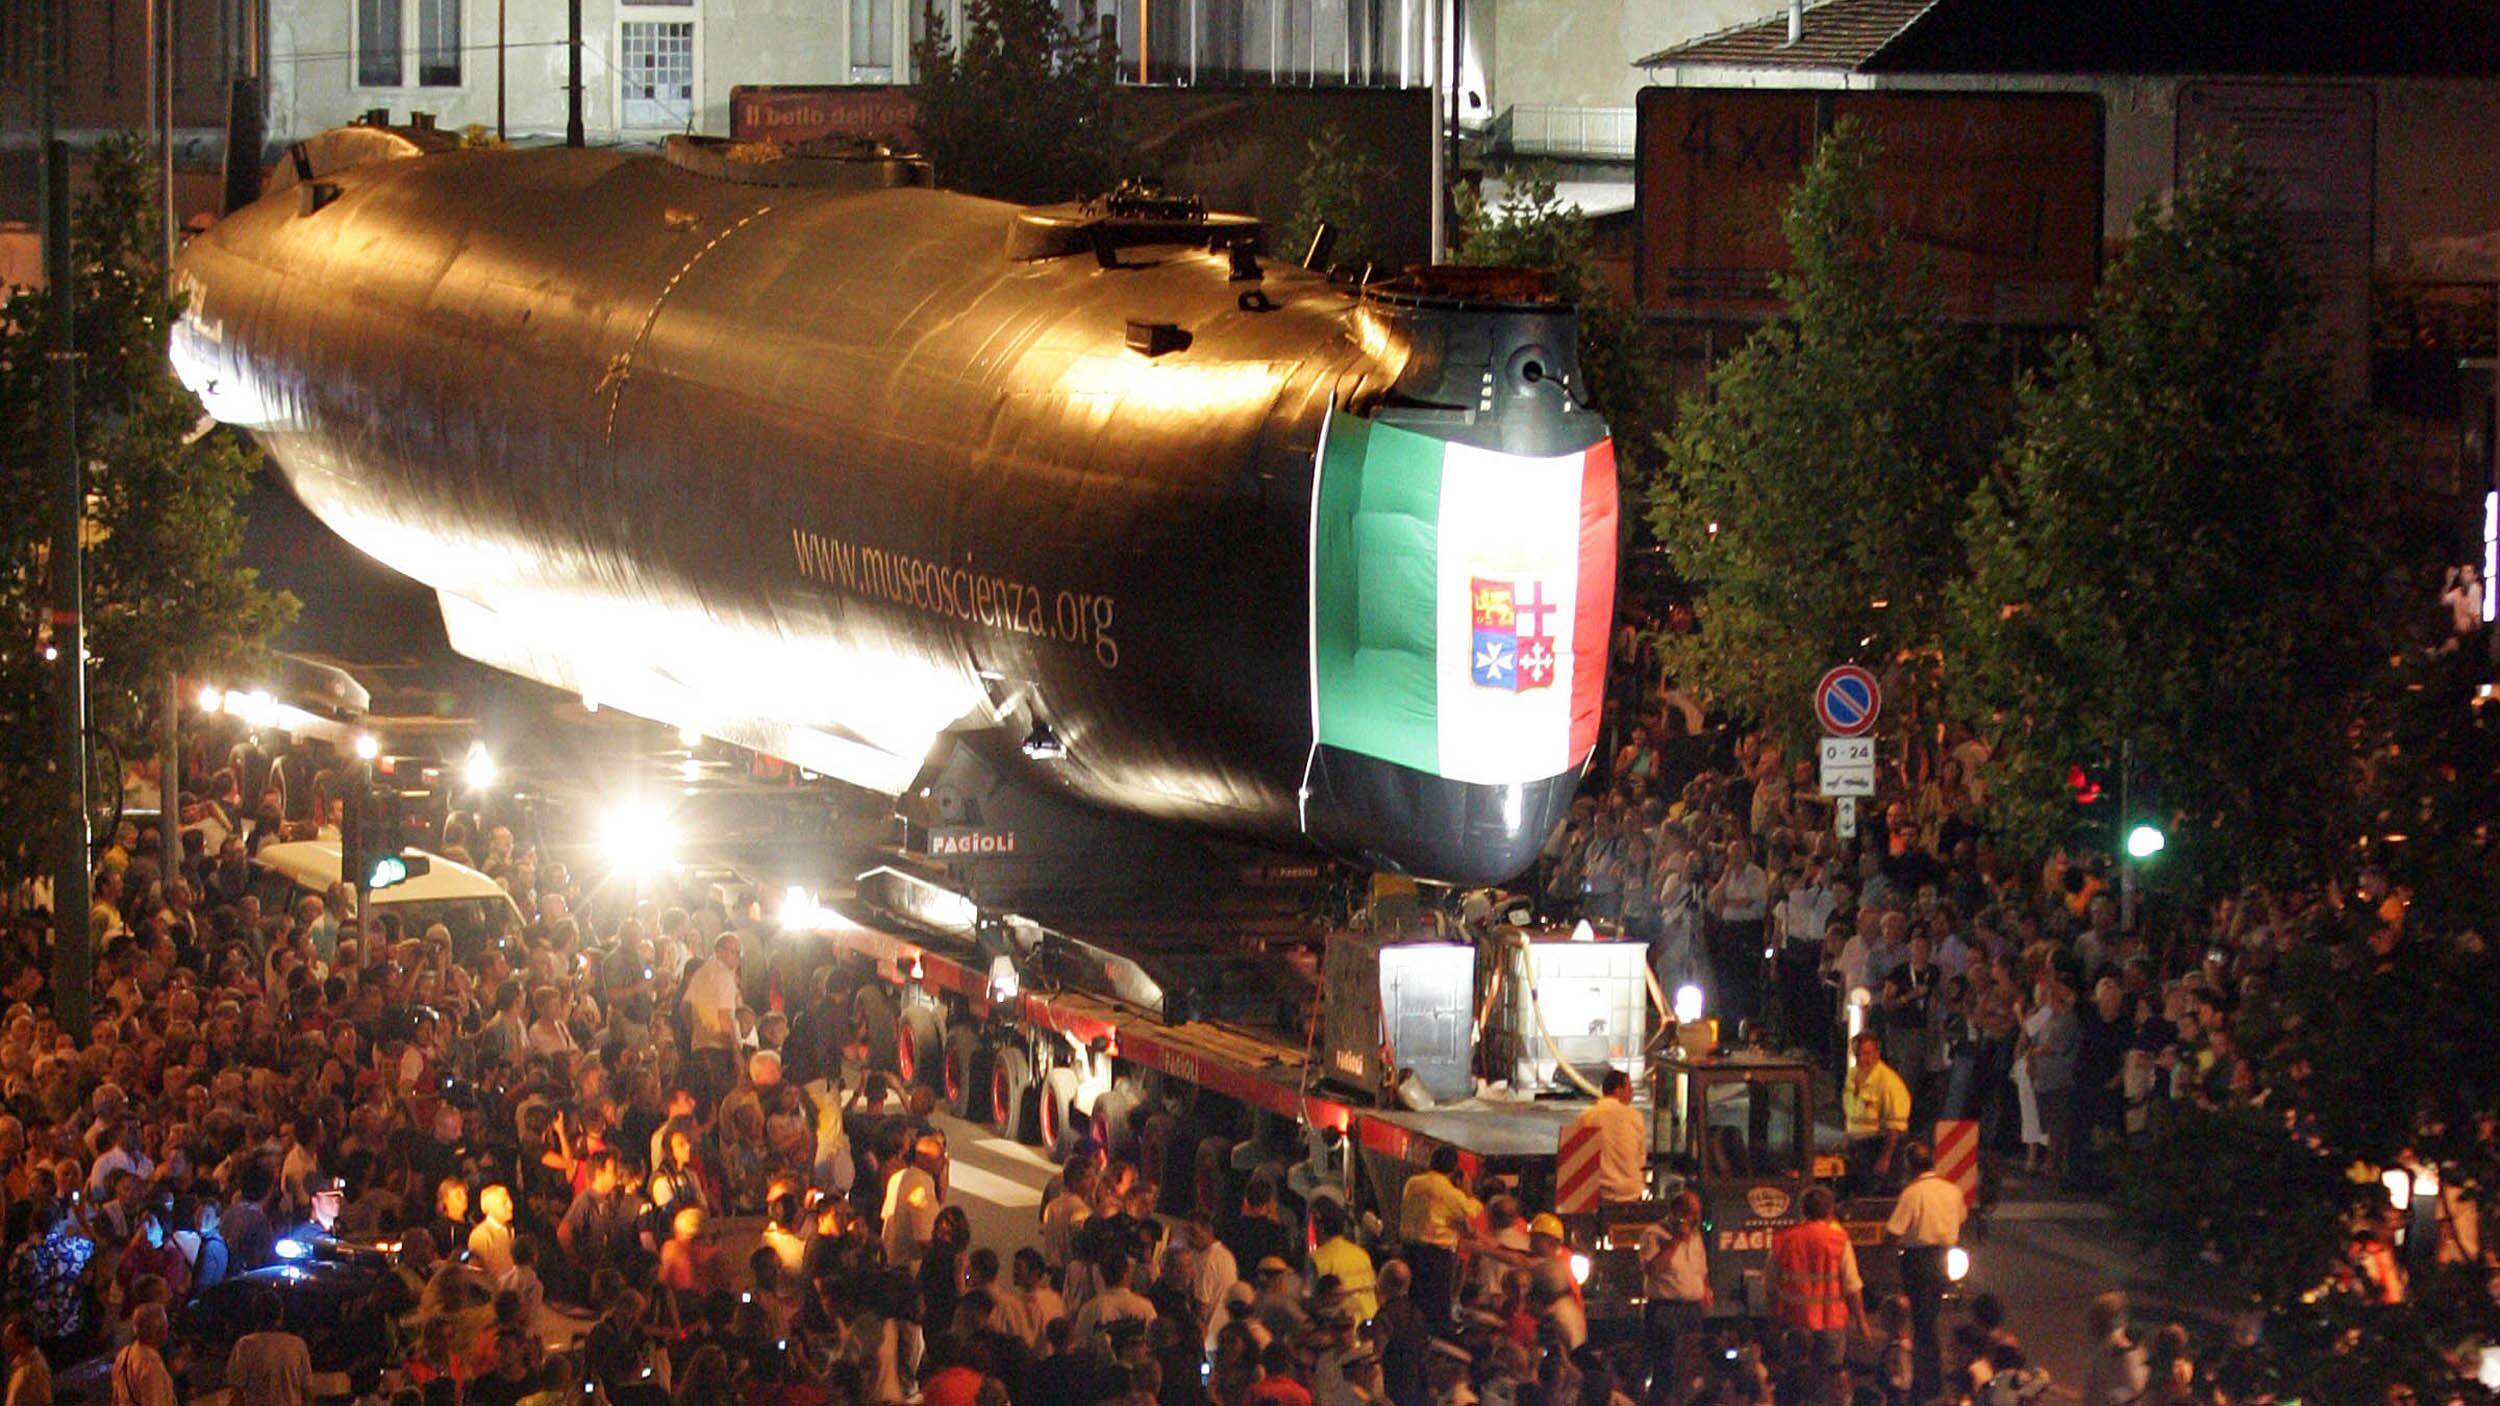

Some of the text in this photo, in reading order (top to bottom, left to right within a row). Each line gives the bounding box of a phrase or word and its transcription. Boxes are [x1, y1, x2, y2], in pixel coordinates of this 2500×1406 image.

[767, 104, 825, 127] bello
[792, 528, 1119, 669] www.museoscienza.org
[1826, 745, 1837, 760] 0
[1850, 745, 1869, 759] 24
